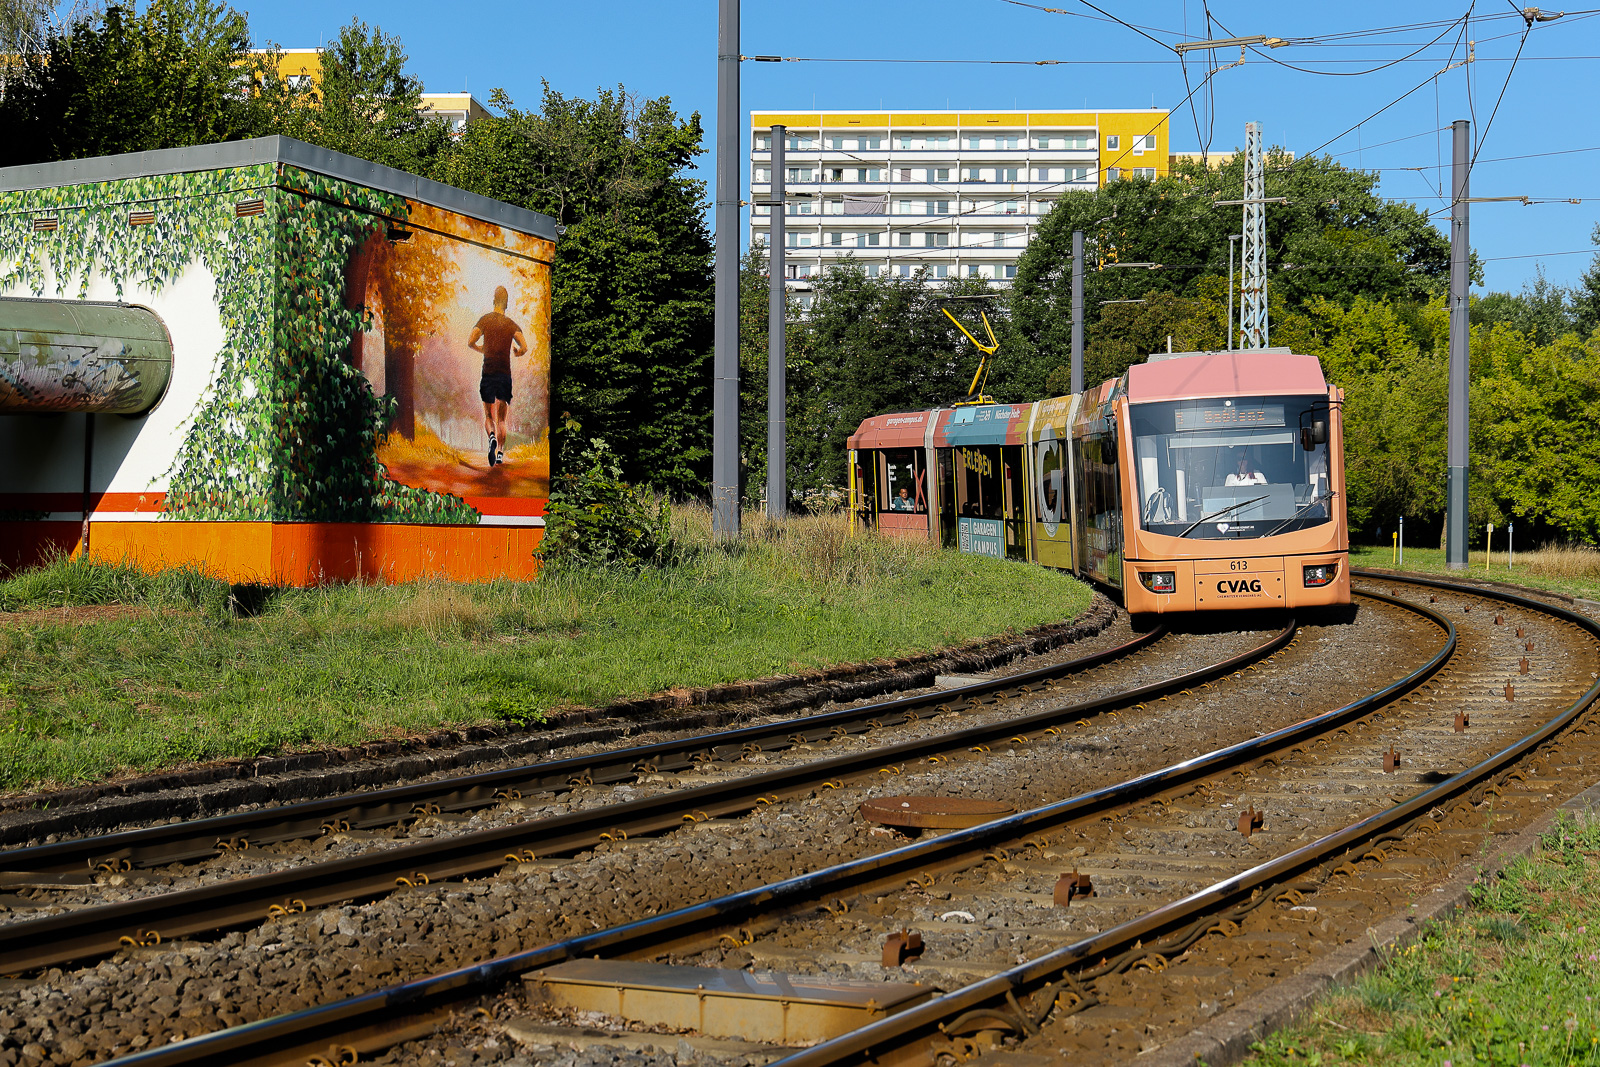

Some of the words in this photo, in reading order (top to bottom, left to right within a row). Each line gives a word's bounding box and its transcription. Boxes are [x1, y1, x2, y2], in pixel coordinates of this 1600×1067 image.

[962, 447, 992, 478] ERLEBEN
[973, 522, 997, 536] GARAGEN
[974, 540, 998, 555] CAMPUS
[1230, 560, 1248, 570] 613
[1217, 579, 1262, 593] CVAG
